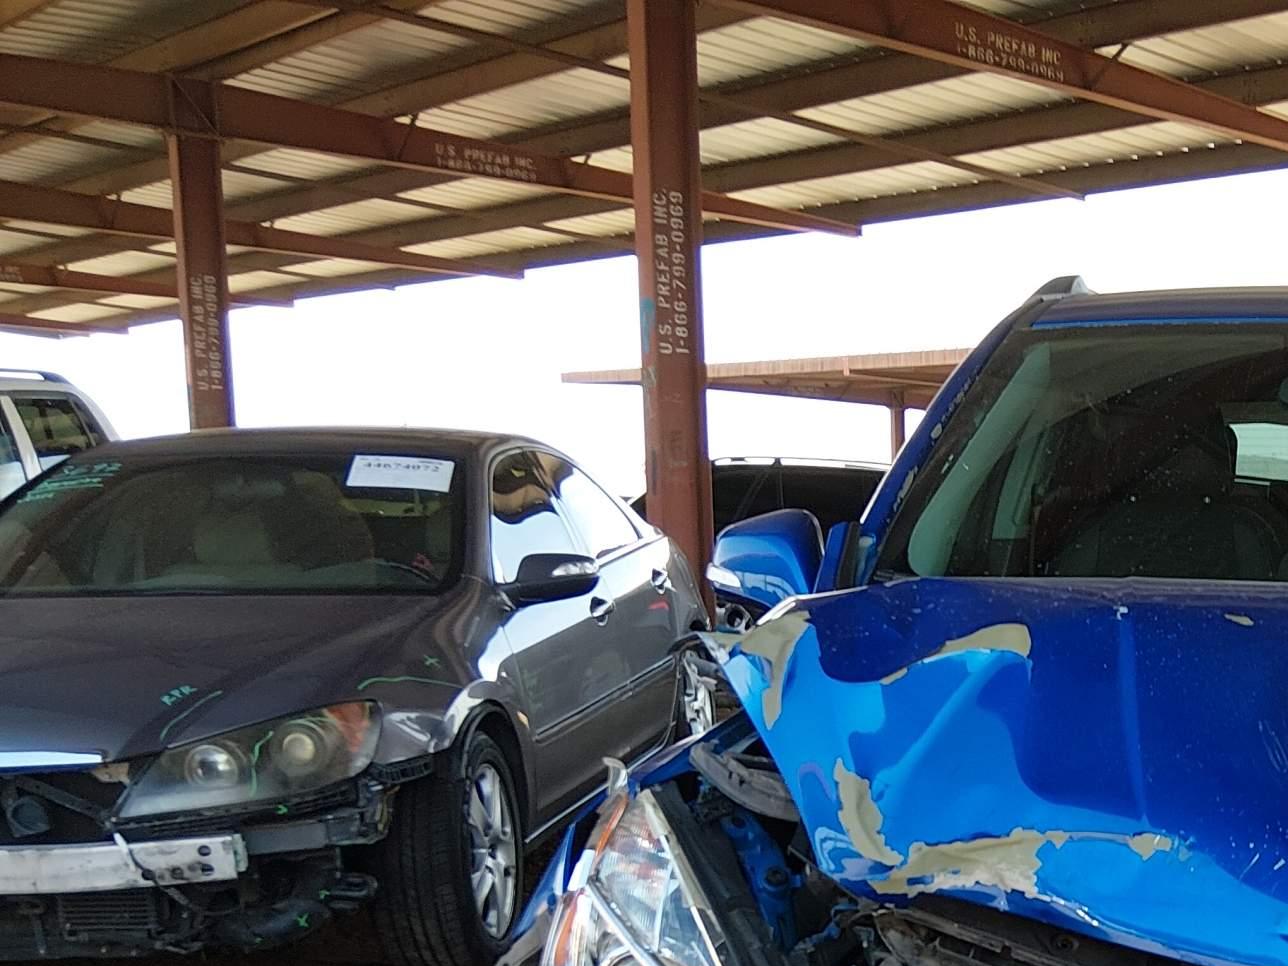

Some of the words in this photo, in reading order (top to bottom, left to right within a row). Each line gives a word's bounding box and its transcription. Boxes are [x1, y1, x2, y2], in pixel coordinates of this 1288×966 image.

[954, 22, 981, 45] U.S.
[987, 31, 1036, 59] PREFAB
[957, 43, 1065, 82] 1-866-799-0969
[653, 188, 669, 224] INC.
[655, 234, 672, 309] PREFAB
[669, 191, 690, 354] 1-866-799-0969
[192, 304, 207, 358] PREFAB
[658, 319, 673, 355] U.S.
